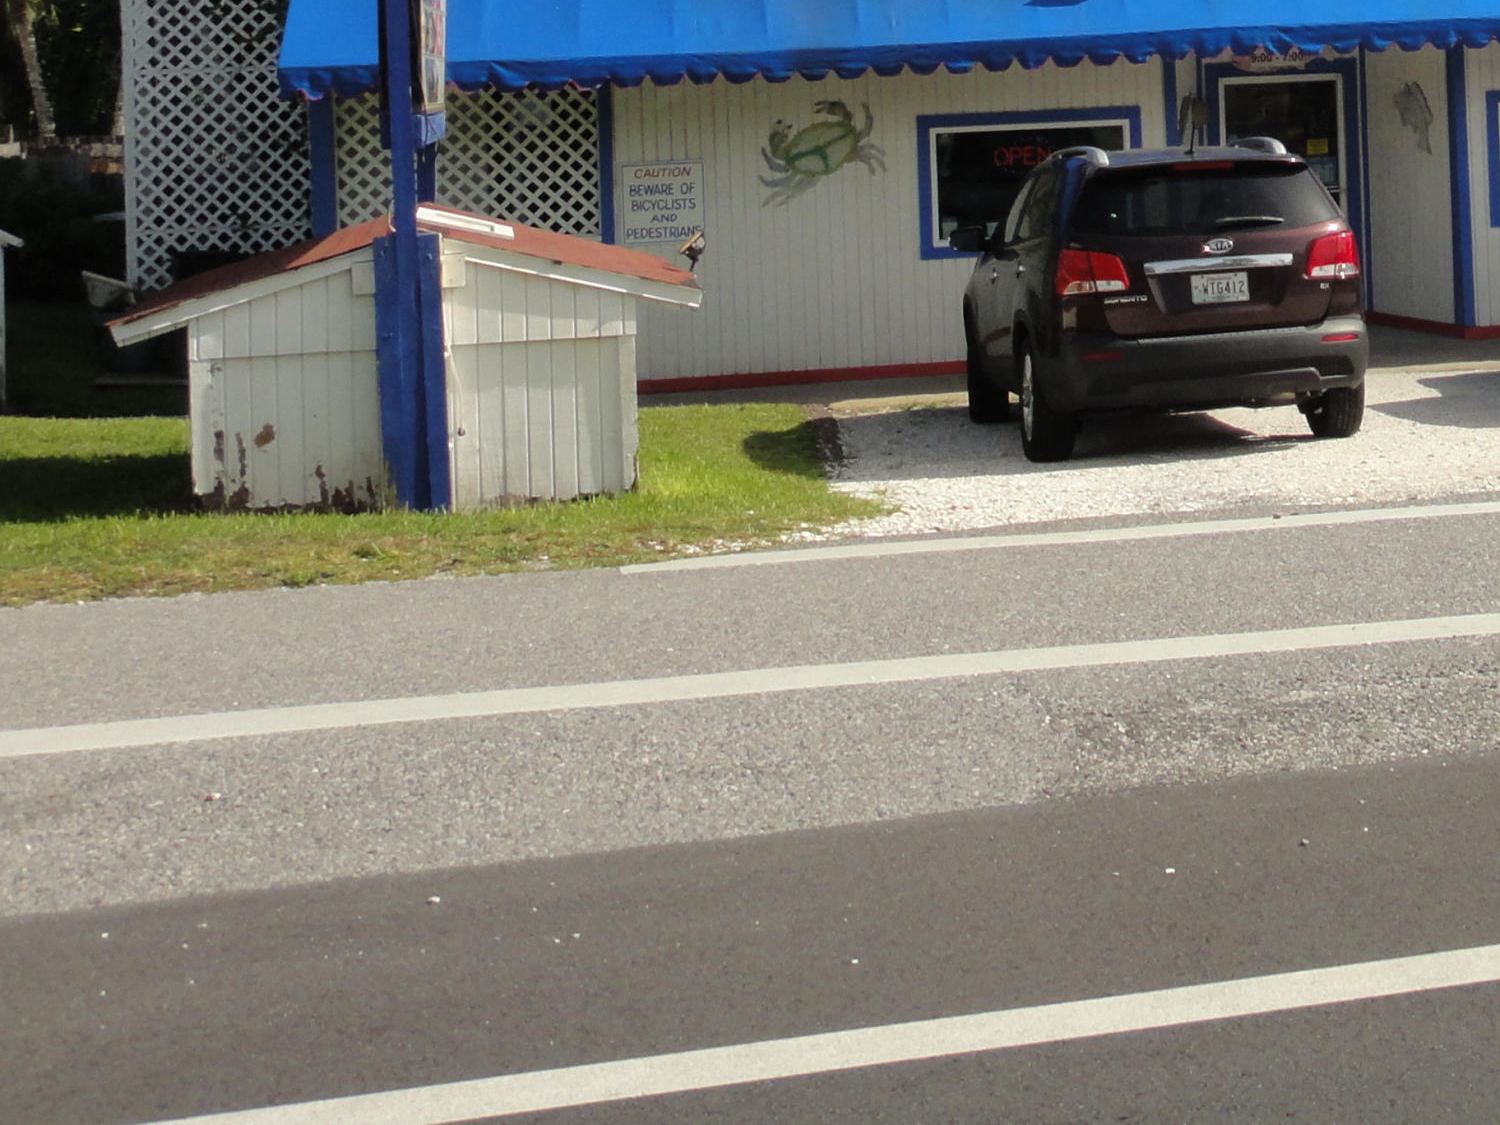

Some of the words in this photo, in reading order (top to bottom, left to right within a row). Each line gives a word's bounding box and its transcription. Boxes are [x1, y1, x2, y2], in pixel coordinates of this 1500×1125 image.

[634, 167, 692, 179] CAUTION
[629, 184, 674, 197] BEWARE
[680, 182, 696, 195] OF
[631, 198, 697, 212] BICYCLISTS
[650, 214, 678, 223] AND
[1203, 280, 1246, 295] WTG412
